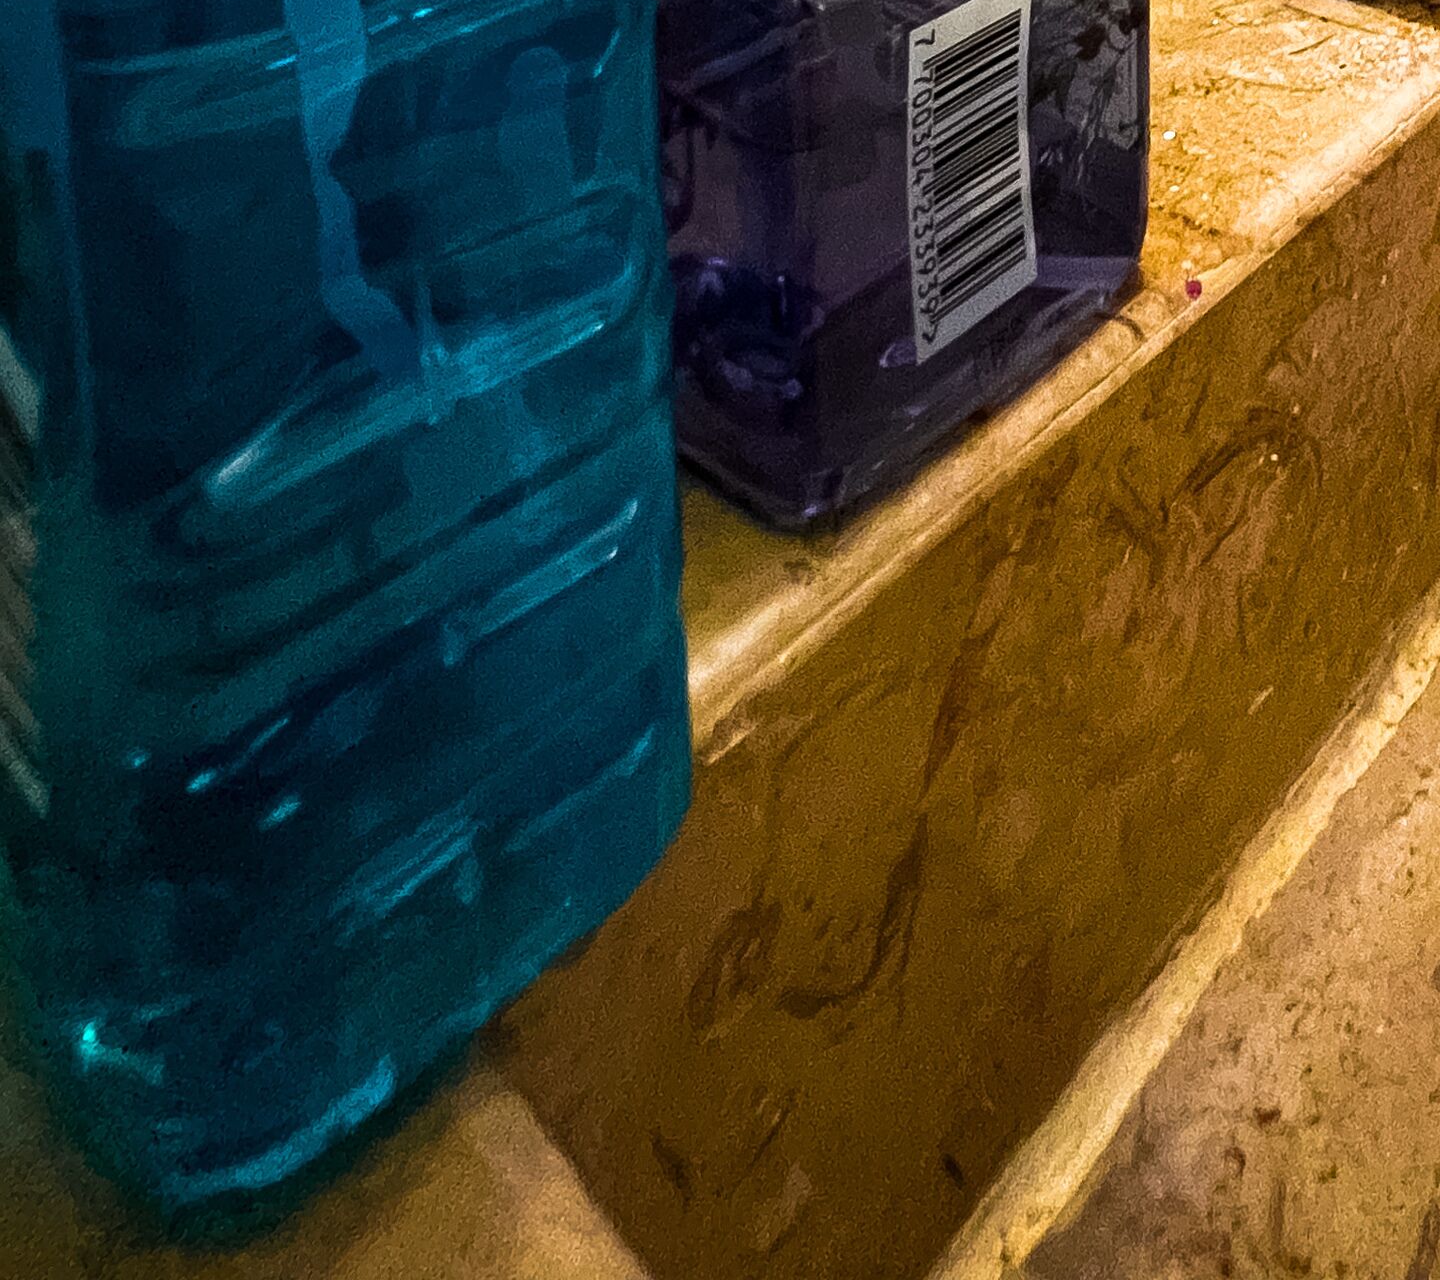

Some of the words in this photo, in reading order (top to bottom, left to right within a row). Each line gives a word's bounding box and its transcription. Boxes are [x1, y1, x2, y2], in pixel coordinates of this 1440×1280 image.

[914, 28, 935, 47] 7
[912, 67, 933, 186] 700304
[912, 197, 940, 314] 233939
